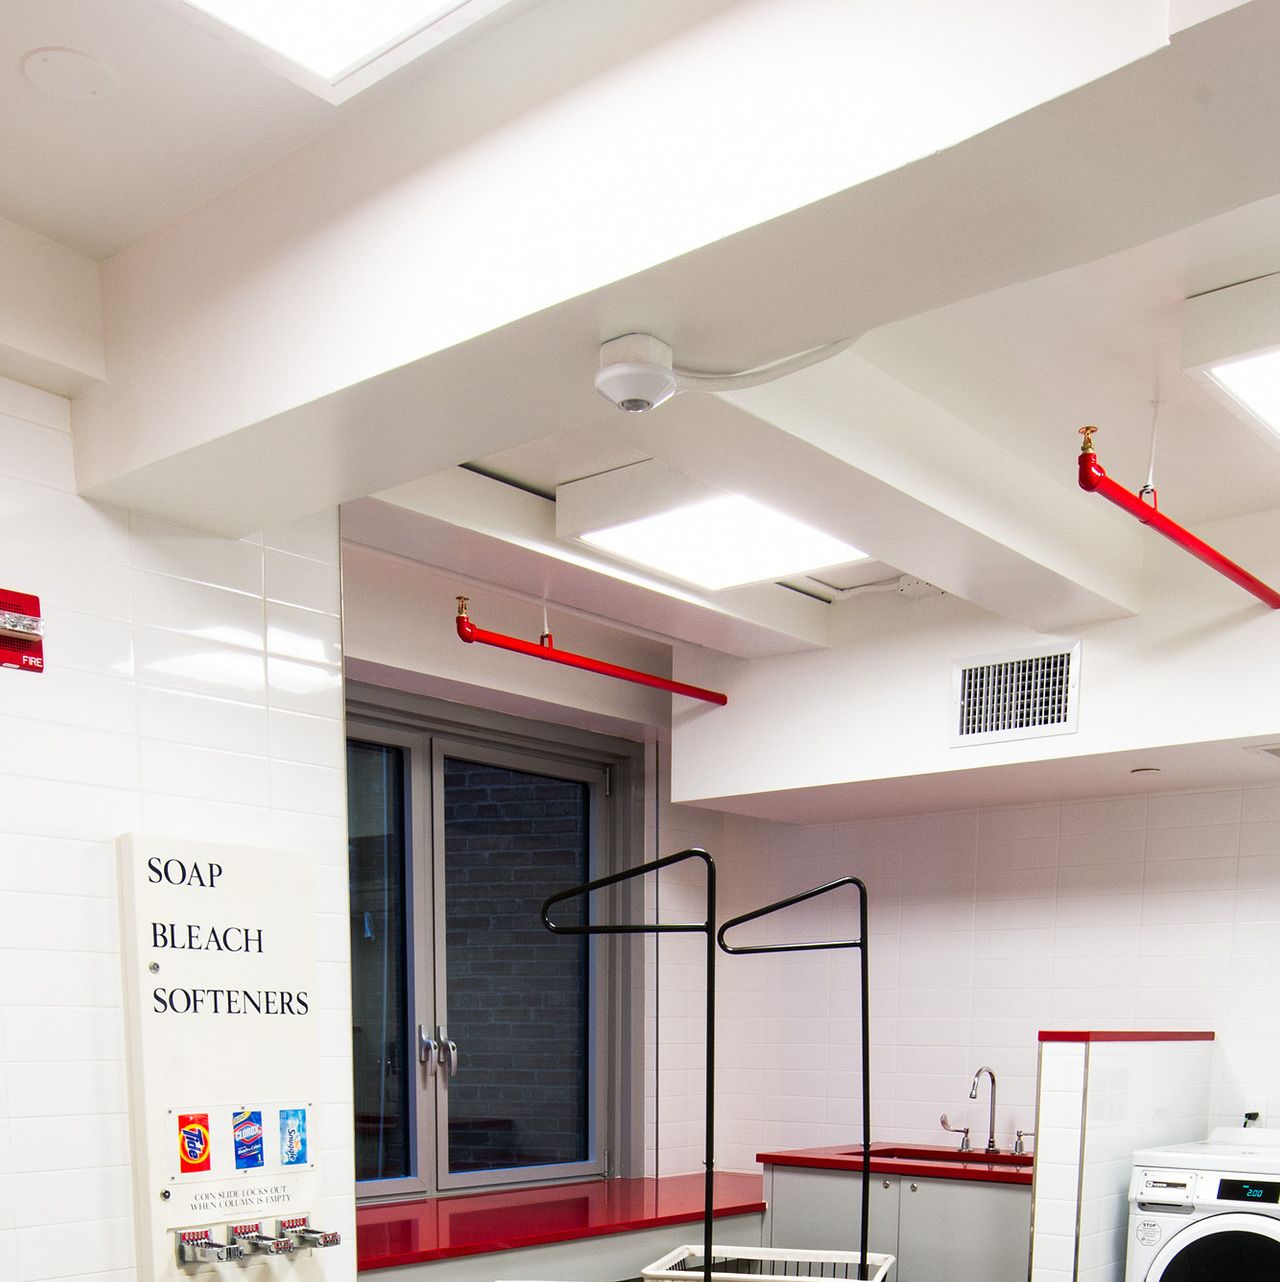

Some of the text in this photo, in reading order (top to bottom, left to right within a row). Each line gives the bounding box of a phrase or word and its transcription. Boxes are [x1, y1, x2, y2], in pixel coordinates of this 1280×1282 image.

[22, 655, 43, 668] FIRE
[147, 856, 223, 888] SOAP
[151, 922, 264, 953] BLEACH
[153, 987, 309, 1016] SOFTENERS
[182, 1128, 204, 1160] Tide
[287, 1129, 297, 1161] Snuggle
[190, 1202, 216, 1210] WHEN
[265, 1194, 290, 1204] EMPTY
[194, 1185, 287, 1201] COIN SLIDE LOCKS OUT
[1246, 1189, 1263, 1197] 2.00
